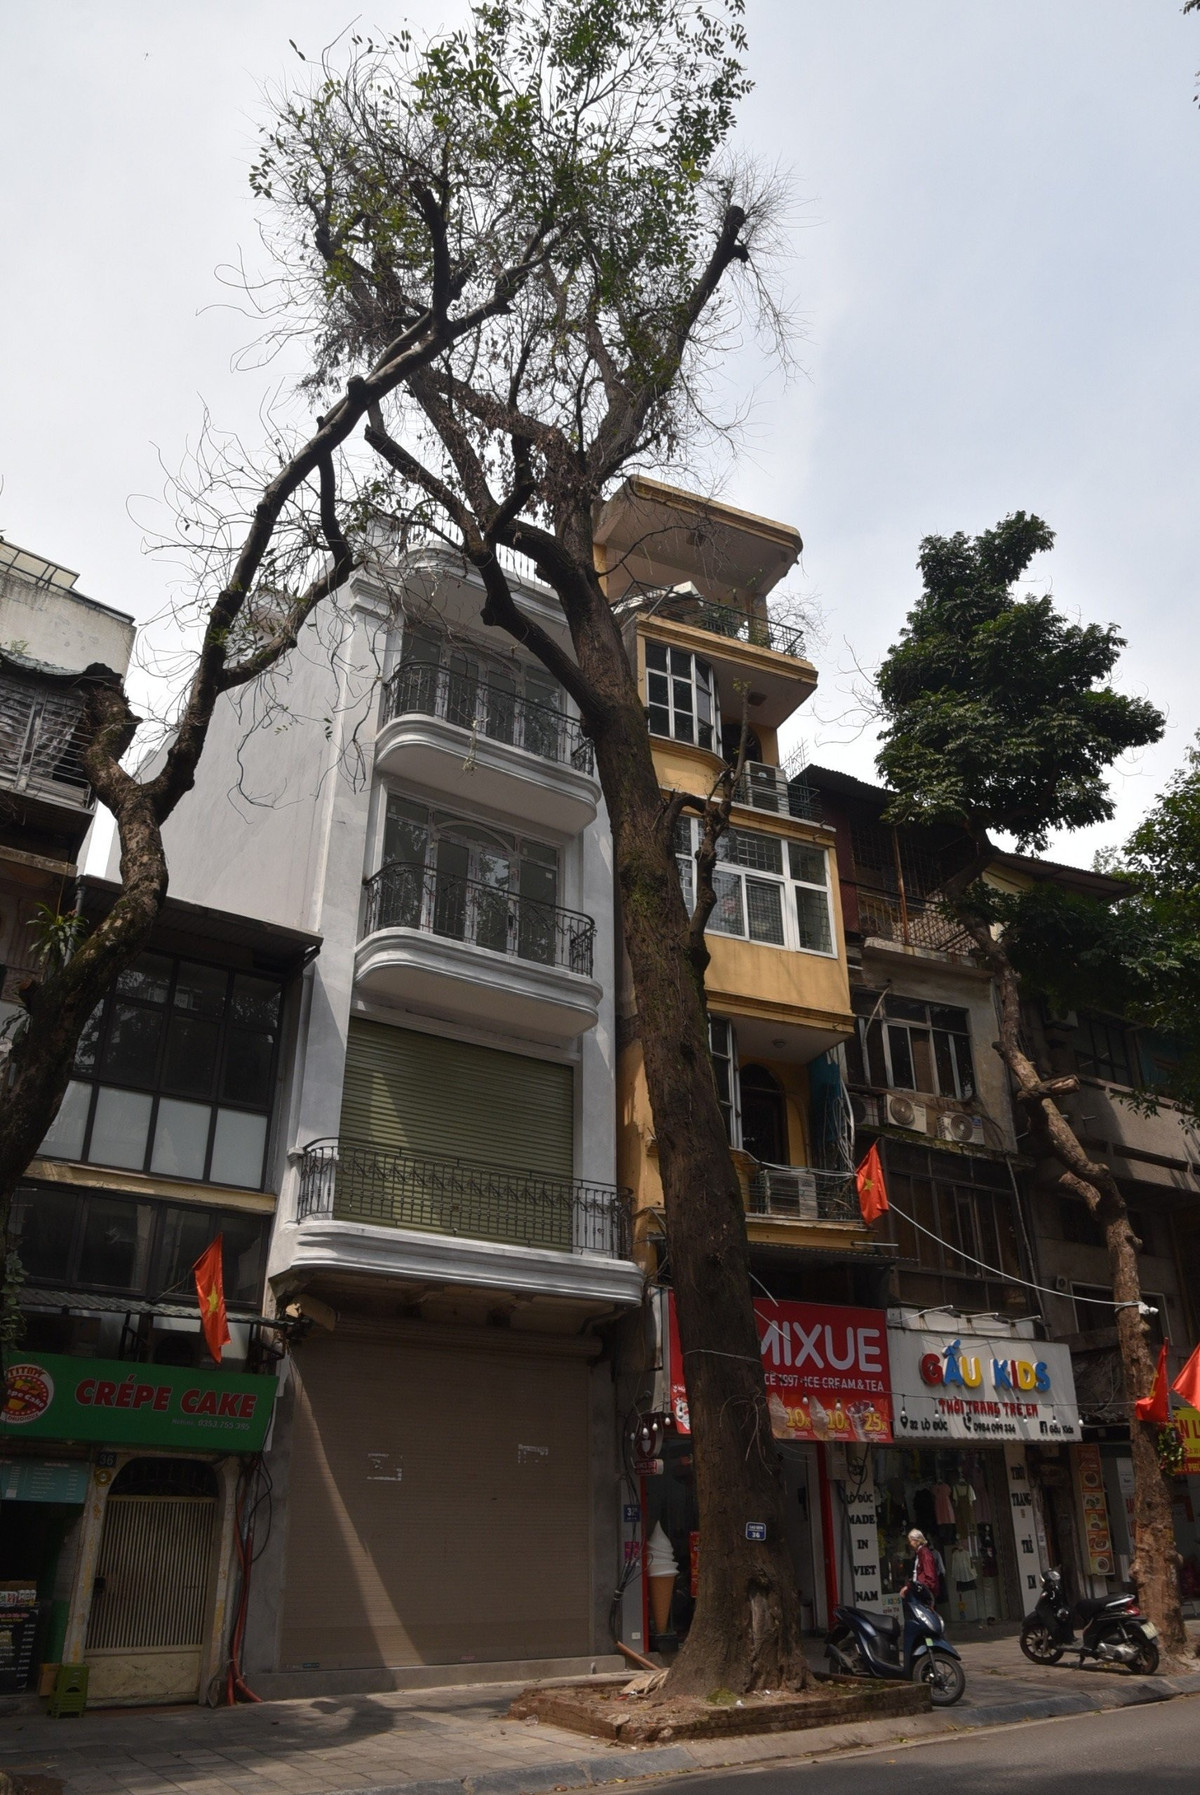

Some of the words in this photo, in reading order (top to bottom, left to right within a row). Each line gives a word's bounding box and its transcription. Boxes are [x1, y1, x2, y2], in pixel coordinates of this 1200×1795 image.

[919, 1339, 981, 1388] GẤU
[990, 1358, 1051, 1391] KIDS
[804, 1376, 820, 1388] ICE
[75, 1373, 172, 1411] CRÉPE
[180, 1389, 257, 1419] CAKE
[966, 1400, 1000, 1415] TRANG
[98, 1454, 114, 1465] 36
[849, 1514, 875, 1524] MADE
[857, 1539, 868, 1549] IN
[854, 1565, 876, 1576] VIET
[855, 1591, 878, 1601] NAM
